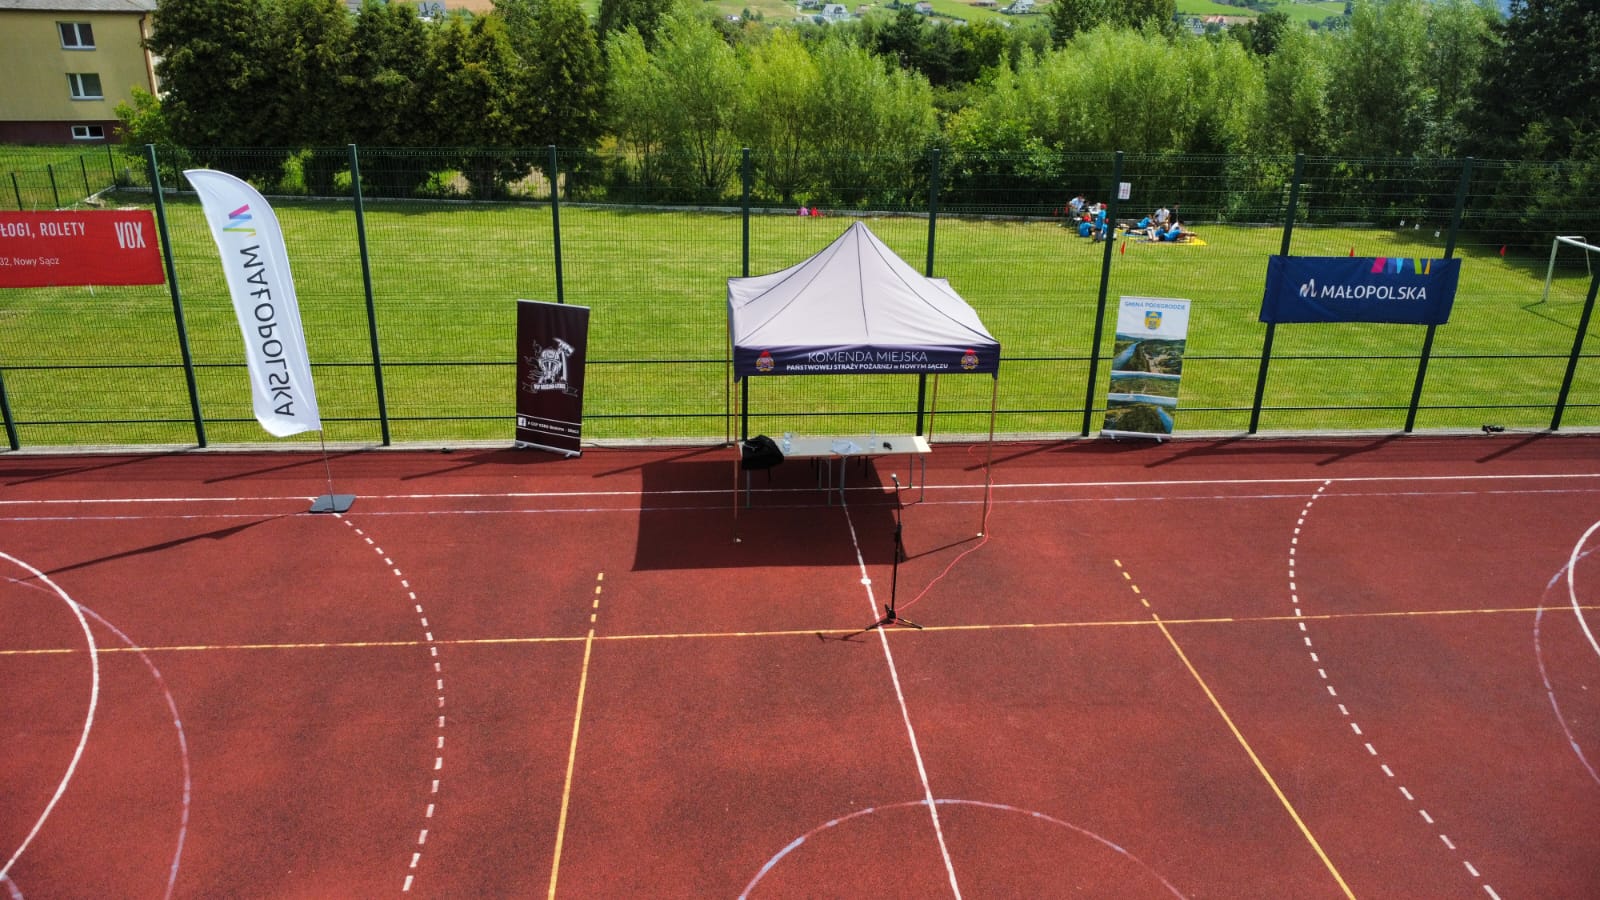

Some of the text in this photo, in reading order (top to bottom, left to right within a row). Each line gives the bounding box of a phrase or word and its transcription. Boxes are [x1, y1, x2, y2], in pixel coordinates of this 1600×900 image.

[40, 221, 85, 237] ROLETY
[114, 221, 146, 249] VOX
[14, 257, 37, 267] Nowy
[39, 256, 60, 267] Sącz
[1320, 285, 1427, 300] MAŁOPOLSKA
[807, 351, 928, 363] KOMENDA MIEJSKA
[786, 363, 833, 371] PAŃSTWOWEJ
[833, 362, 858, 370] STRAŻY
[859, 362, 893, 370] POŻARNEJ
